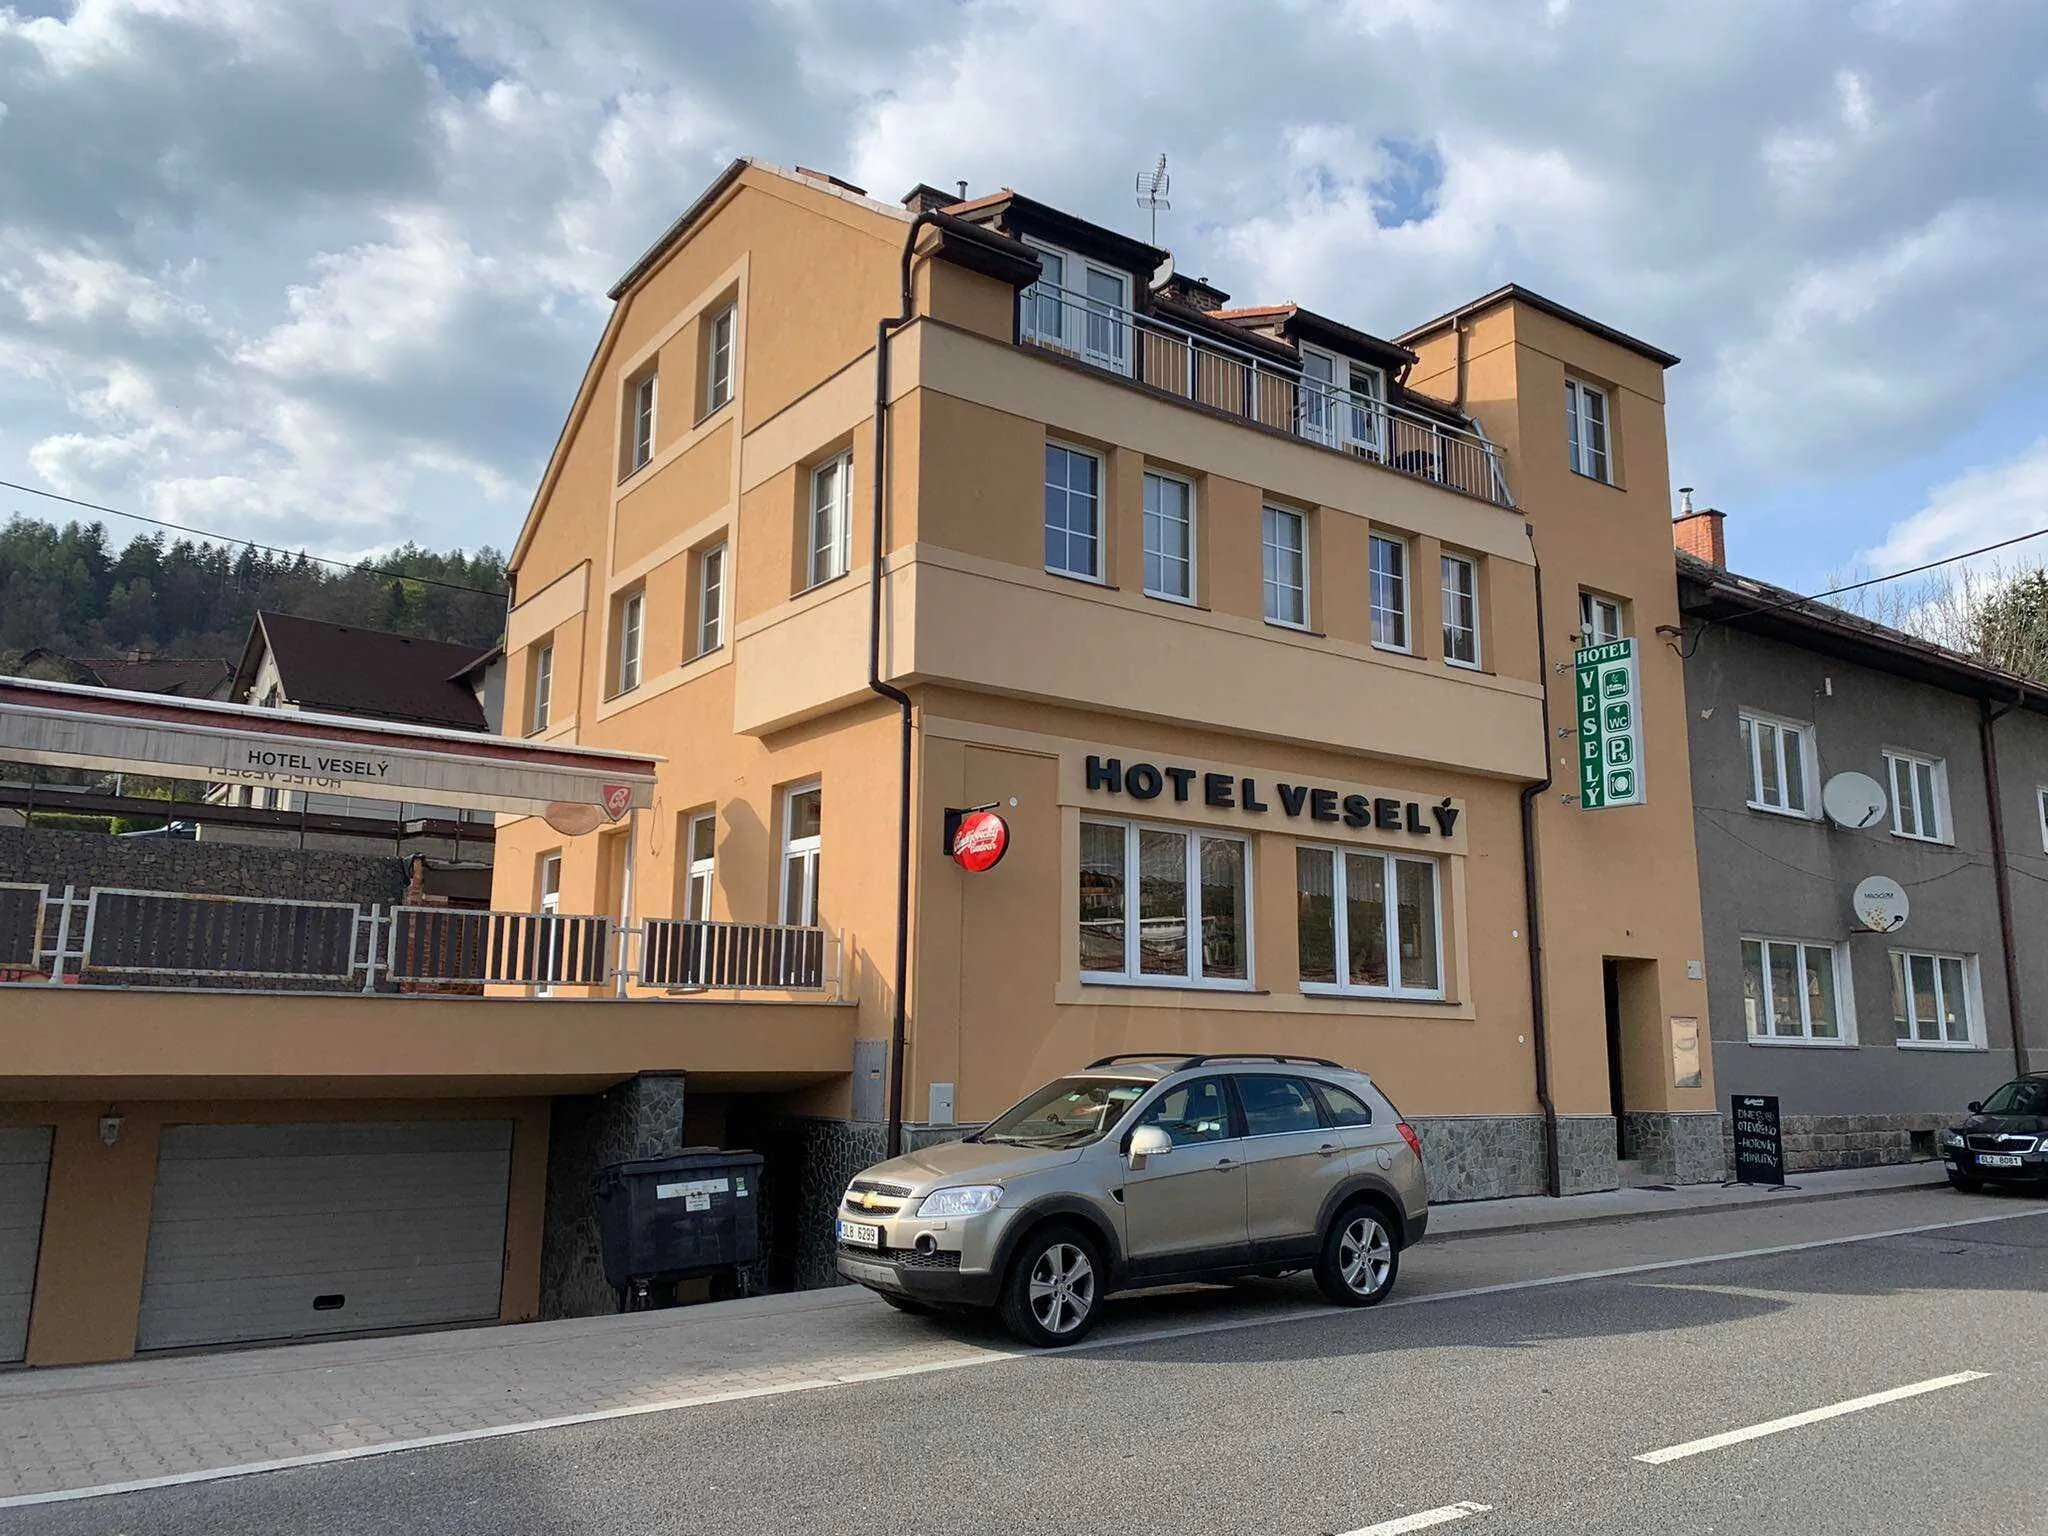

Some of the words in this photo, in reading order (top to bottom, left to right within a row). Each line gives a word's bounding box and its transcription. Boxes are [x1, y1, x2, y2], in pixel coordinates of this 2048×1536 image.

[1577, 642, 1629, 666] HOTEL
[1609, 715, 1628, 729] WC
[1580, 670, 1601, 806] VESELÝ
[1611, 740, 1625, 761] P
[248, 750, 311, 770] HOTEL
[318, 757, 389, 777] VESELÝ
[1085, 754, 1268, 812] HOTEL
[1278, 782, 1460, 837] VESELÝ
[857, 1226, 875, 1242] 6299
